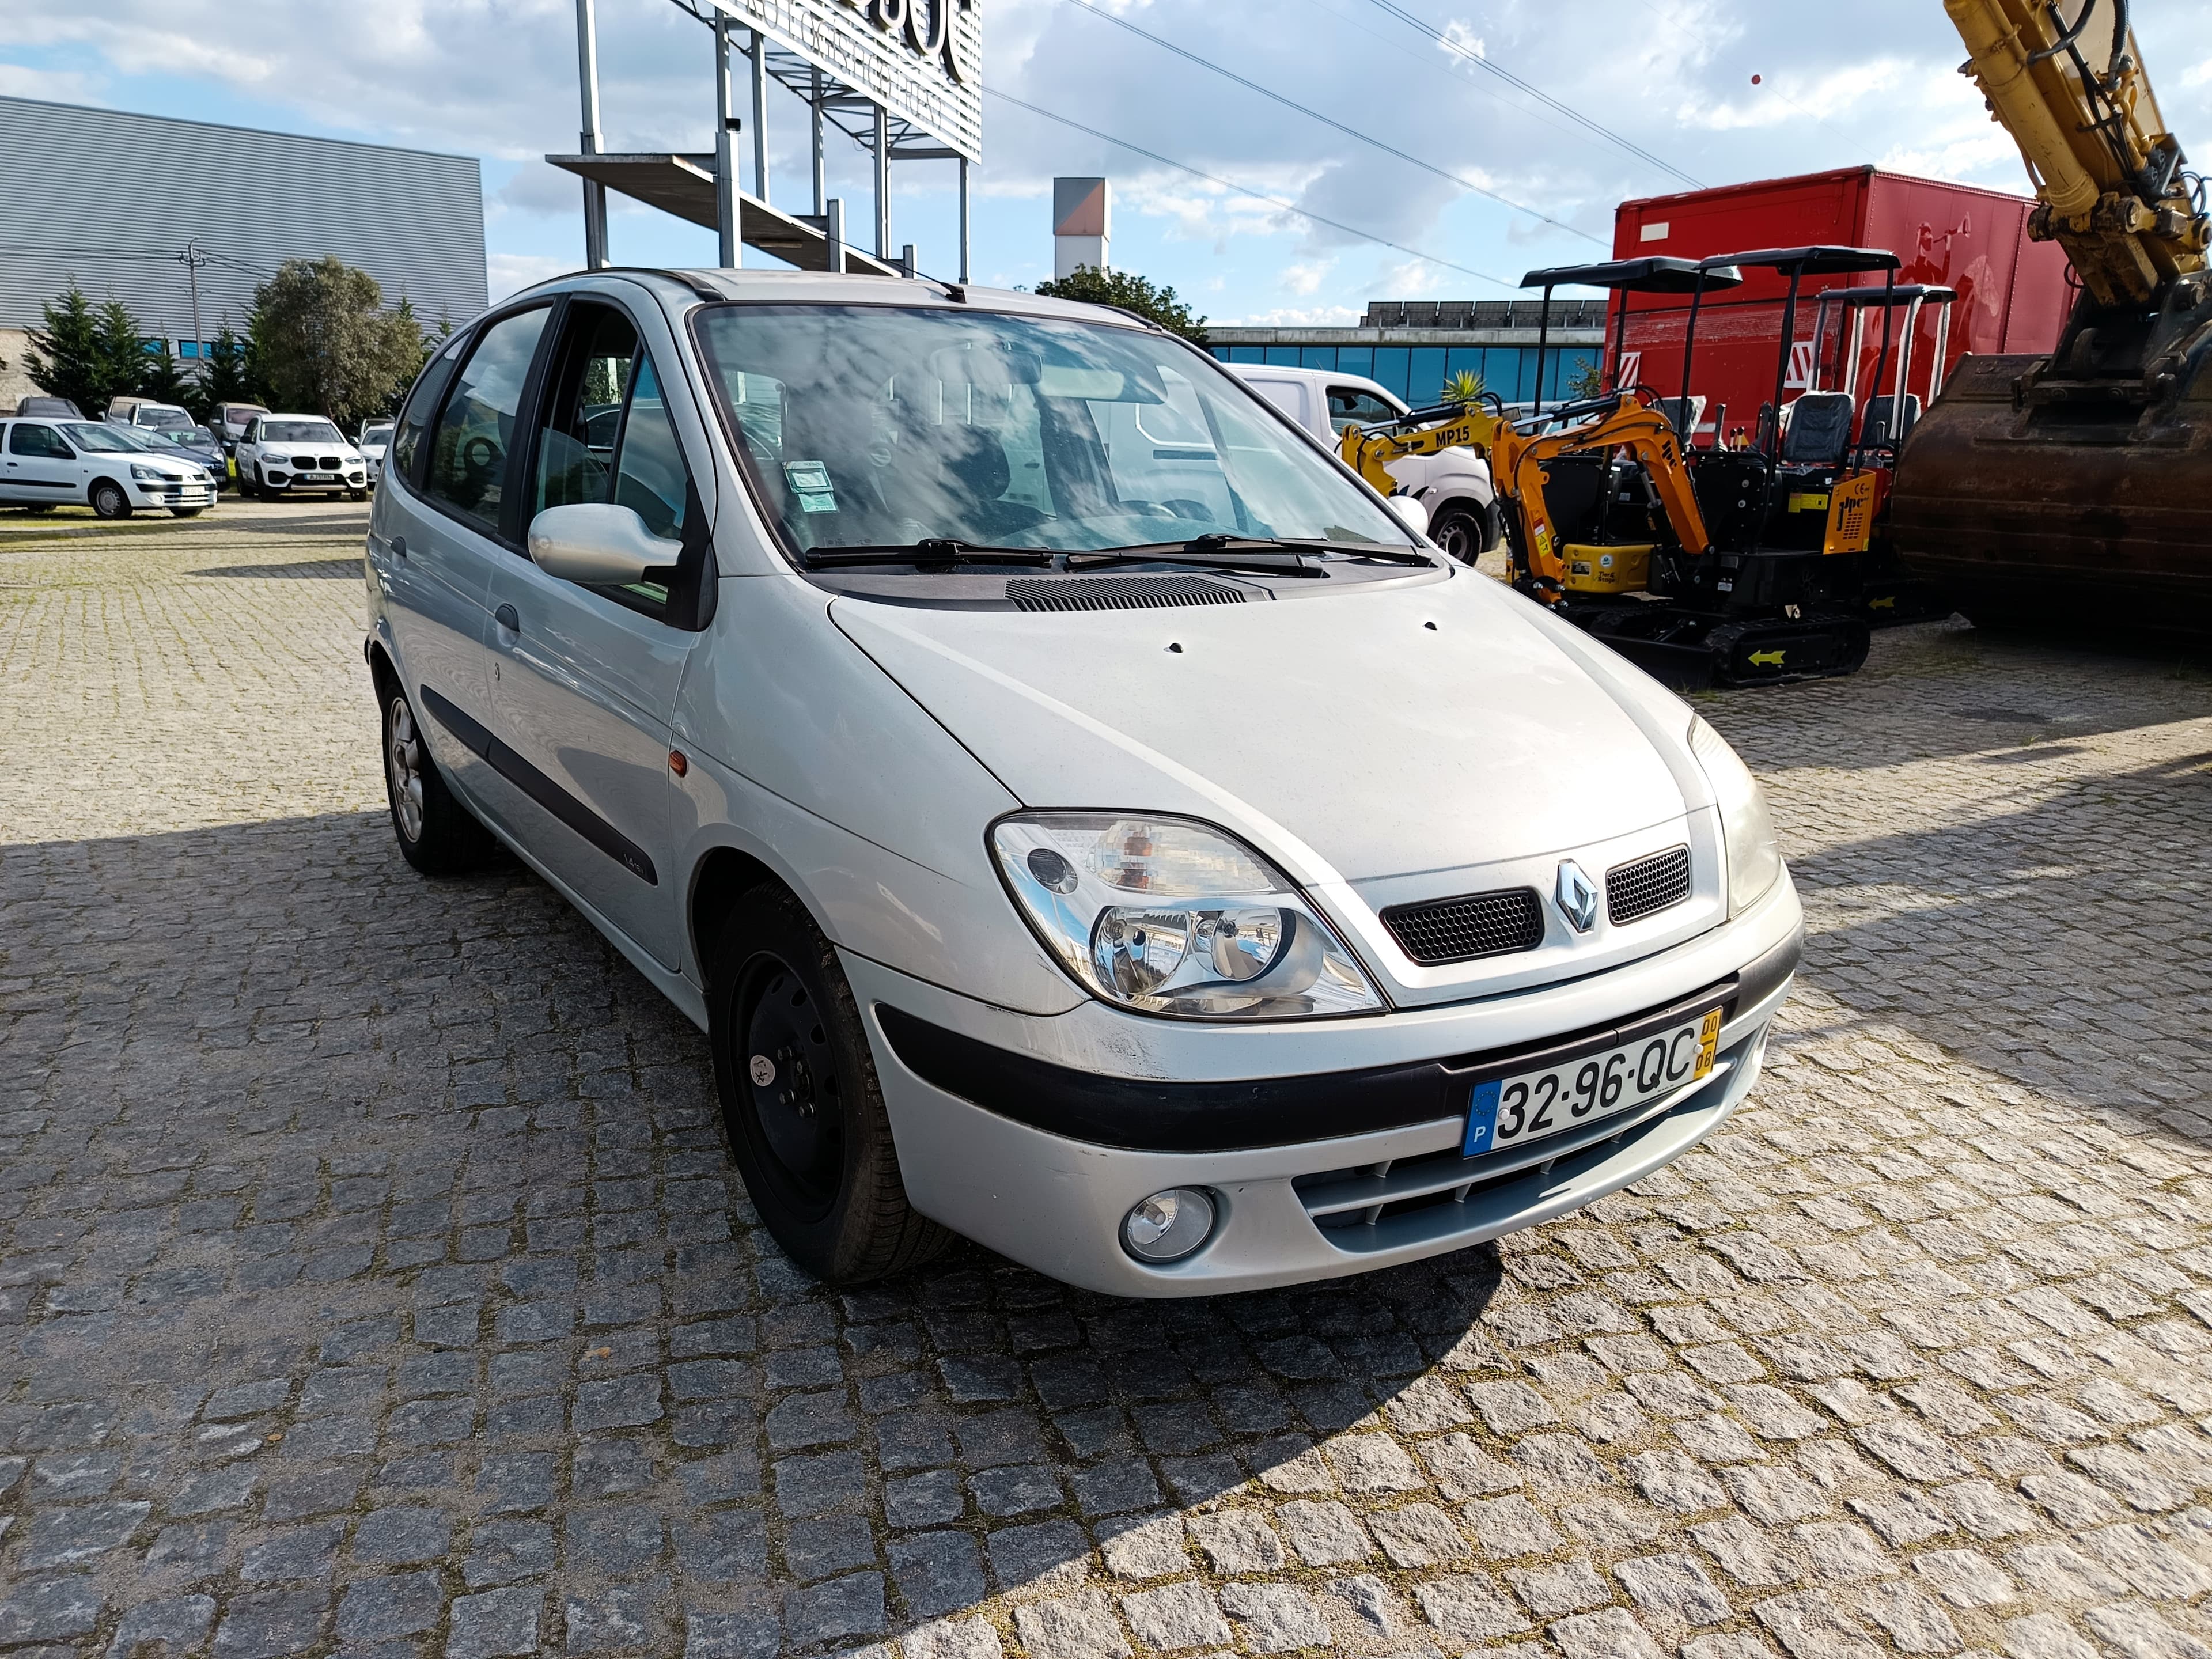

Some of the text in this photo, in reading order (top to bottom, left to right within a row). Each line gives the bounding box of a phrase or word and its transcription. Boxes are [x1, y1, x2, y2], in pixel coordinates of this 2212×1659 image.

[1435, 425, 1470, 448] MP15
[1702, 1016, 1717, 1036] 00
[1696, 1051, 1711, 1071] 08
[1474, 1126, 1486, 1142] P
